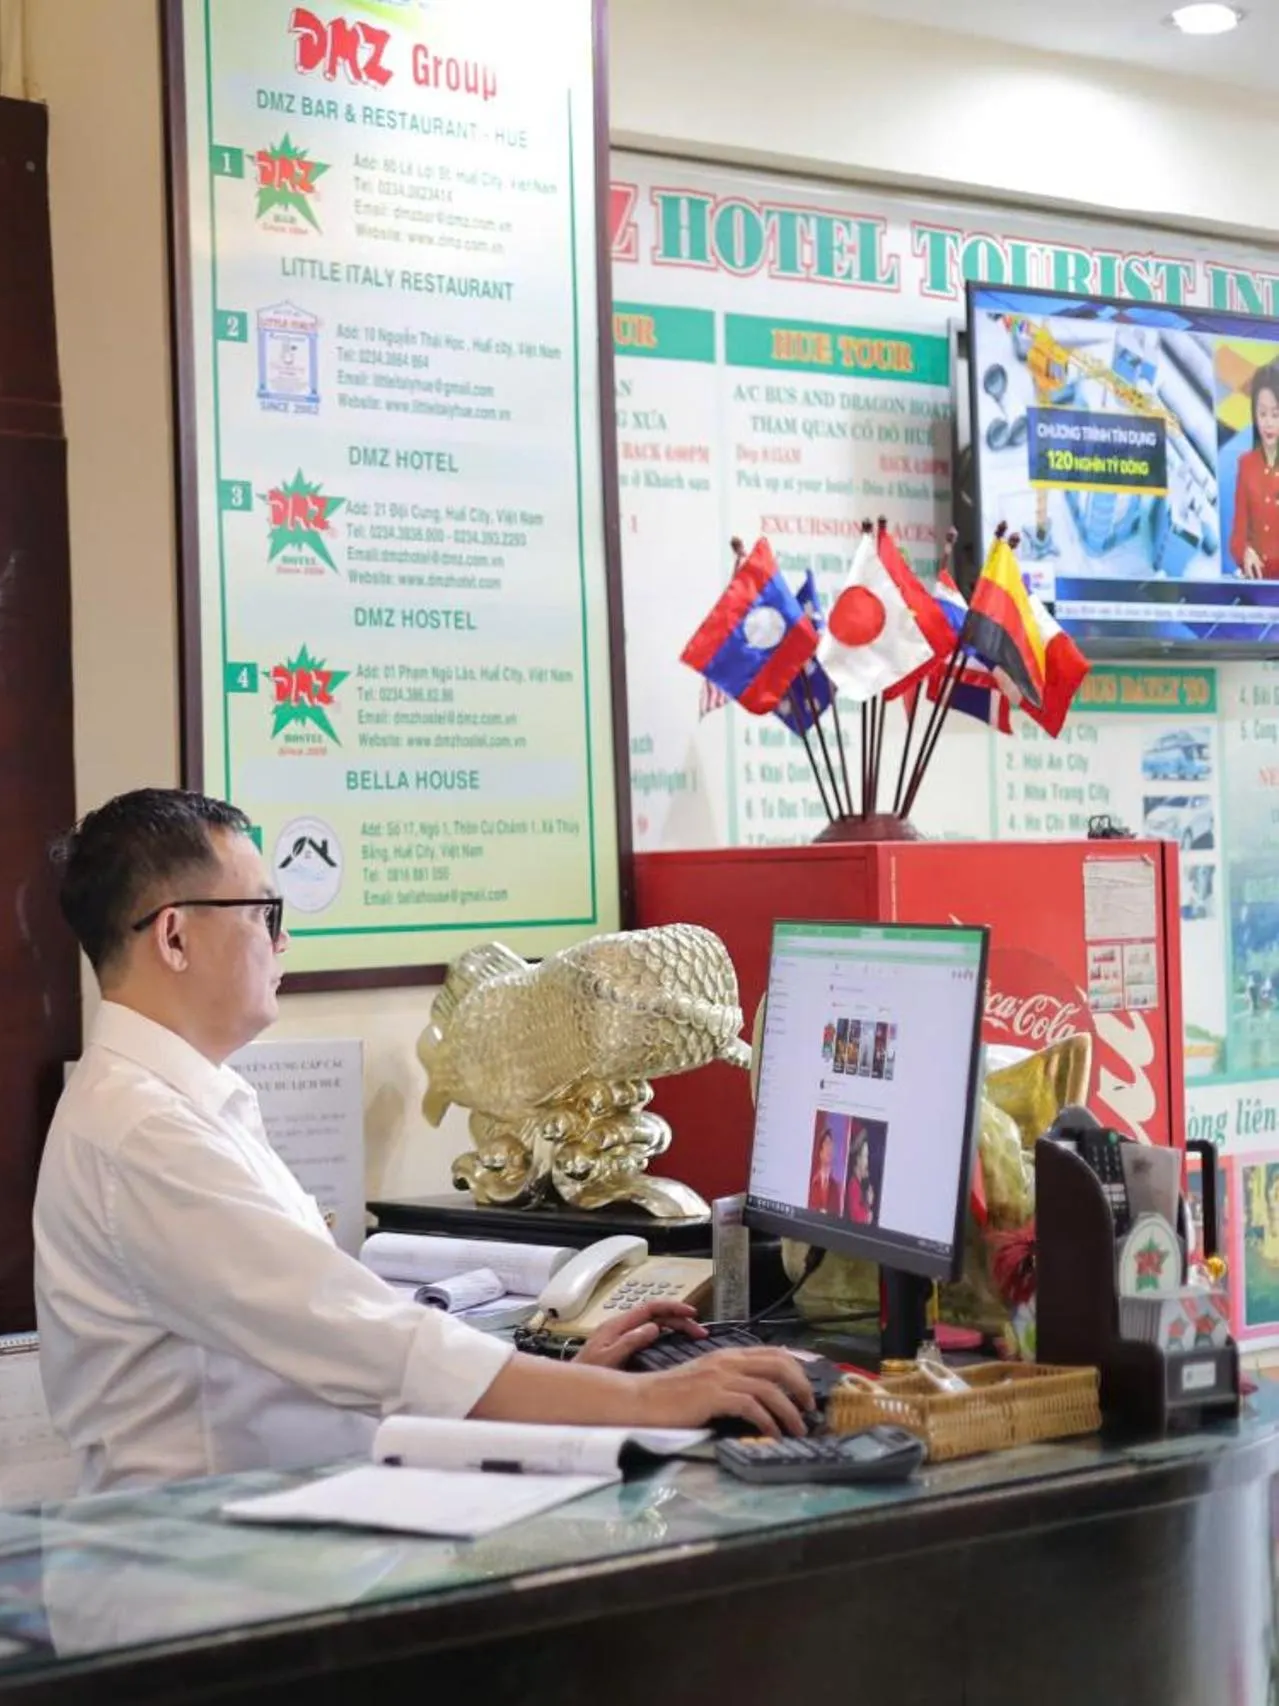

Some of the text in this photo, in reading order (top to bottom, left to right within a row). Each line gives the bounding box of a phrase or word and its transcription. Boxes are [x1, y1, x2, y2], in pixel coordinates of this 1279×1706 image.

[412, 44, 497, 102] Group
[256, 88, 529, 149] DMZ BAR & RESTAURANT HUE
[221, 151, 232, 174] 1
[651, 187, 901, 293] HOTEL
[911, 220, 1197, 305] TOURIST
[281, 257, 514, 301] LITTLE ITALY RESTAURANT
[226, 314, 239, 337] 2
[772, 328, 914, 374] HUE TOUR
[765, 385, 798, 405] BUS
[802, 387, 836, 409] AND
[839, 390, 907, 415] DRAGON
[348, 445, 459, 474] DMZ HOTEL
[1047, 449, 1073, 470] 120
[354, 607, 478, 631] DMZ HOSTEL
[236, 665, 249, 689] 4
[346, 769, 481, 792] BELLA HOUSE
